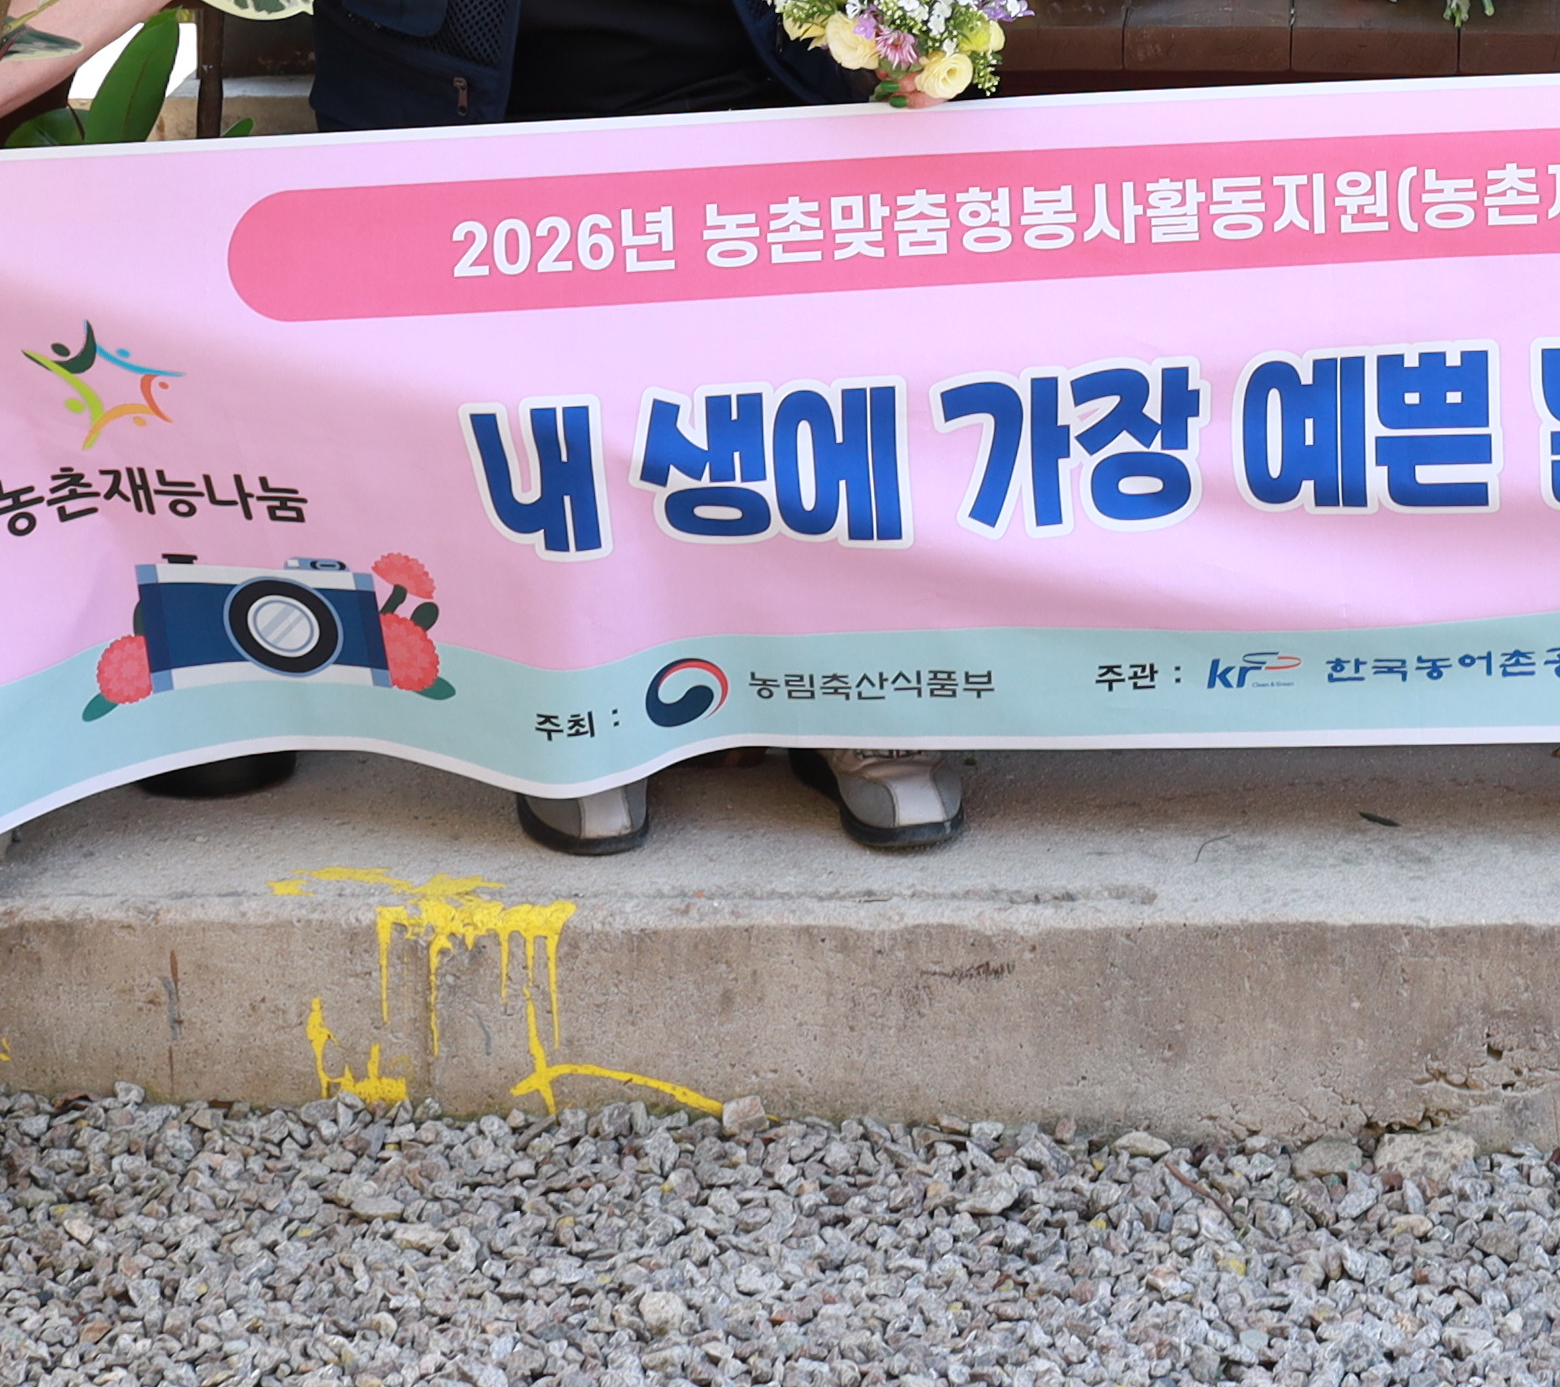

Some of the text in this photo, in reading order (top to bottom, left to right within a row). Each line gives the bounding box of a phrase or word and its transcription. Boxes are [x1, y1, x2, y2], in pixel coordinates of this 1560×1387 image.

[452, 206, 675, 277] 2026년
[470, 405, 602, 553] 내
[641, 386, 903, 541] 생에
[940, 366, 1200, 528] 가장
[1242, 350, 1493, 508] 예쁜
[748, 670, 995, 701] 농림축산식품부
[1095, 663, 1159, 692] 주관
[535, 711, 595, 741] 주최
